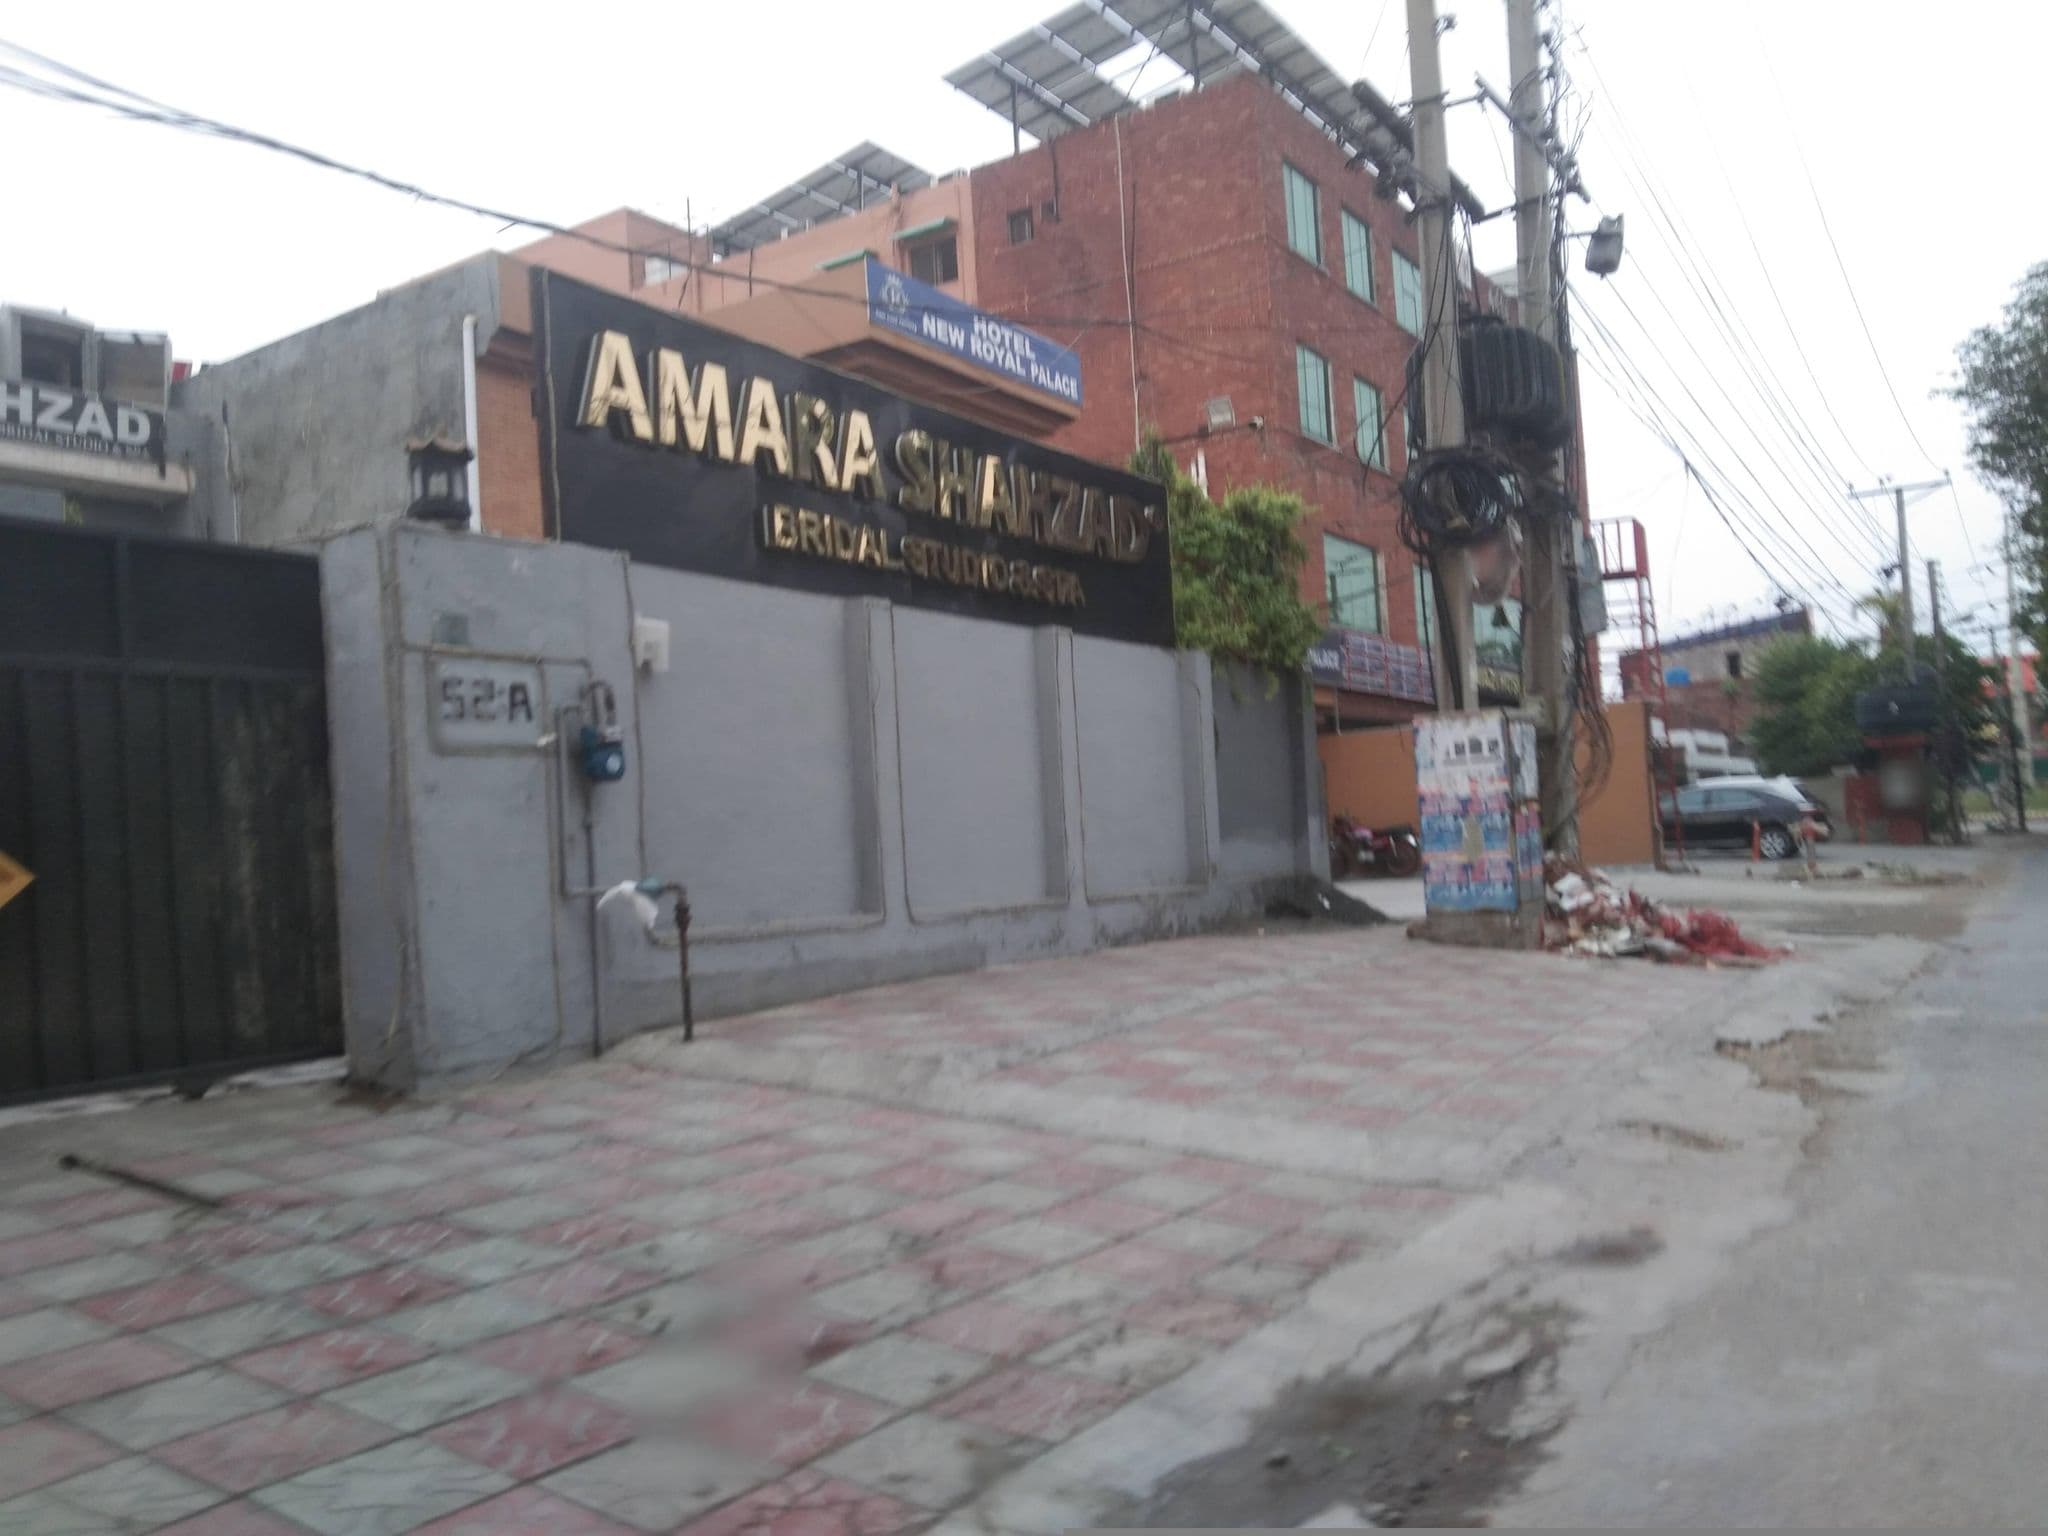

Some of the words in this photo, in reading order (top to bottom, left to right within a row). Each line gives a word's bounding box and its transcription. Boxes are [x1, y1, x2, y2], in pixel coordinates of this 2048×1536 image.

[922, 312, 965, 351] NEW
[970, 335, 1027, 378] ROYAL
[1030, 362, 1078, 400] PALACE
[973, 315, 1036, 360] HOTEL
[577, 329, 886, 498] AMARA
[895, 428, 1150, 564] SHAHZAD
[762, 503, 905, 570] BRIDAL
[901, 535, 1008, 590] STUDIO
